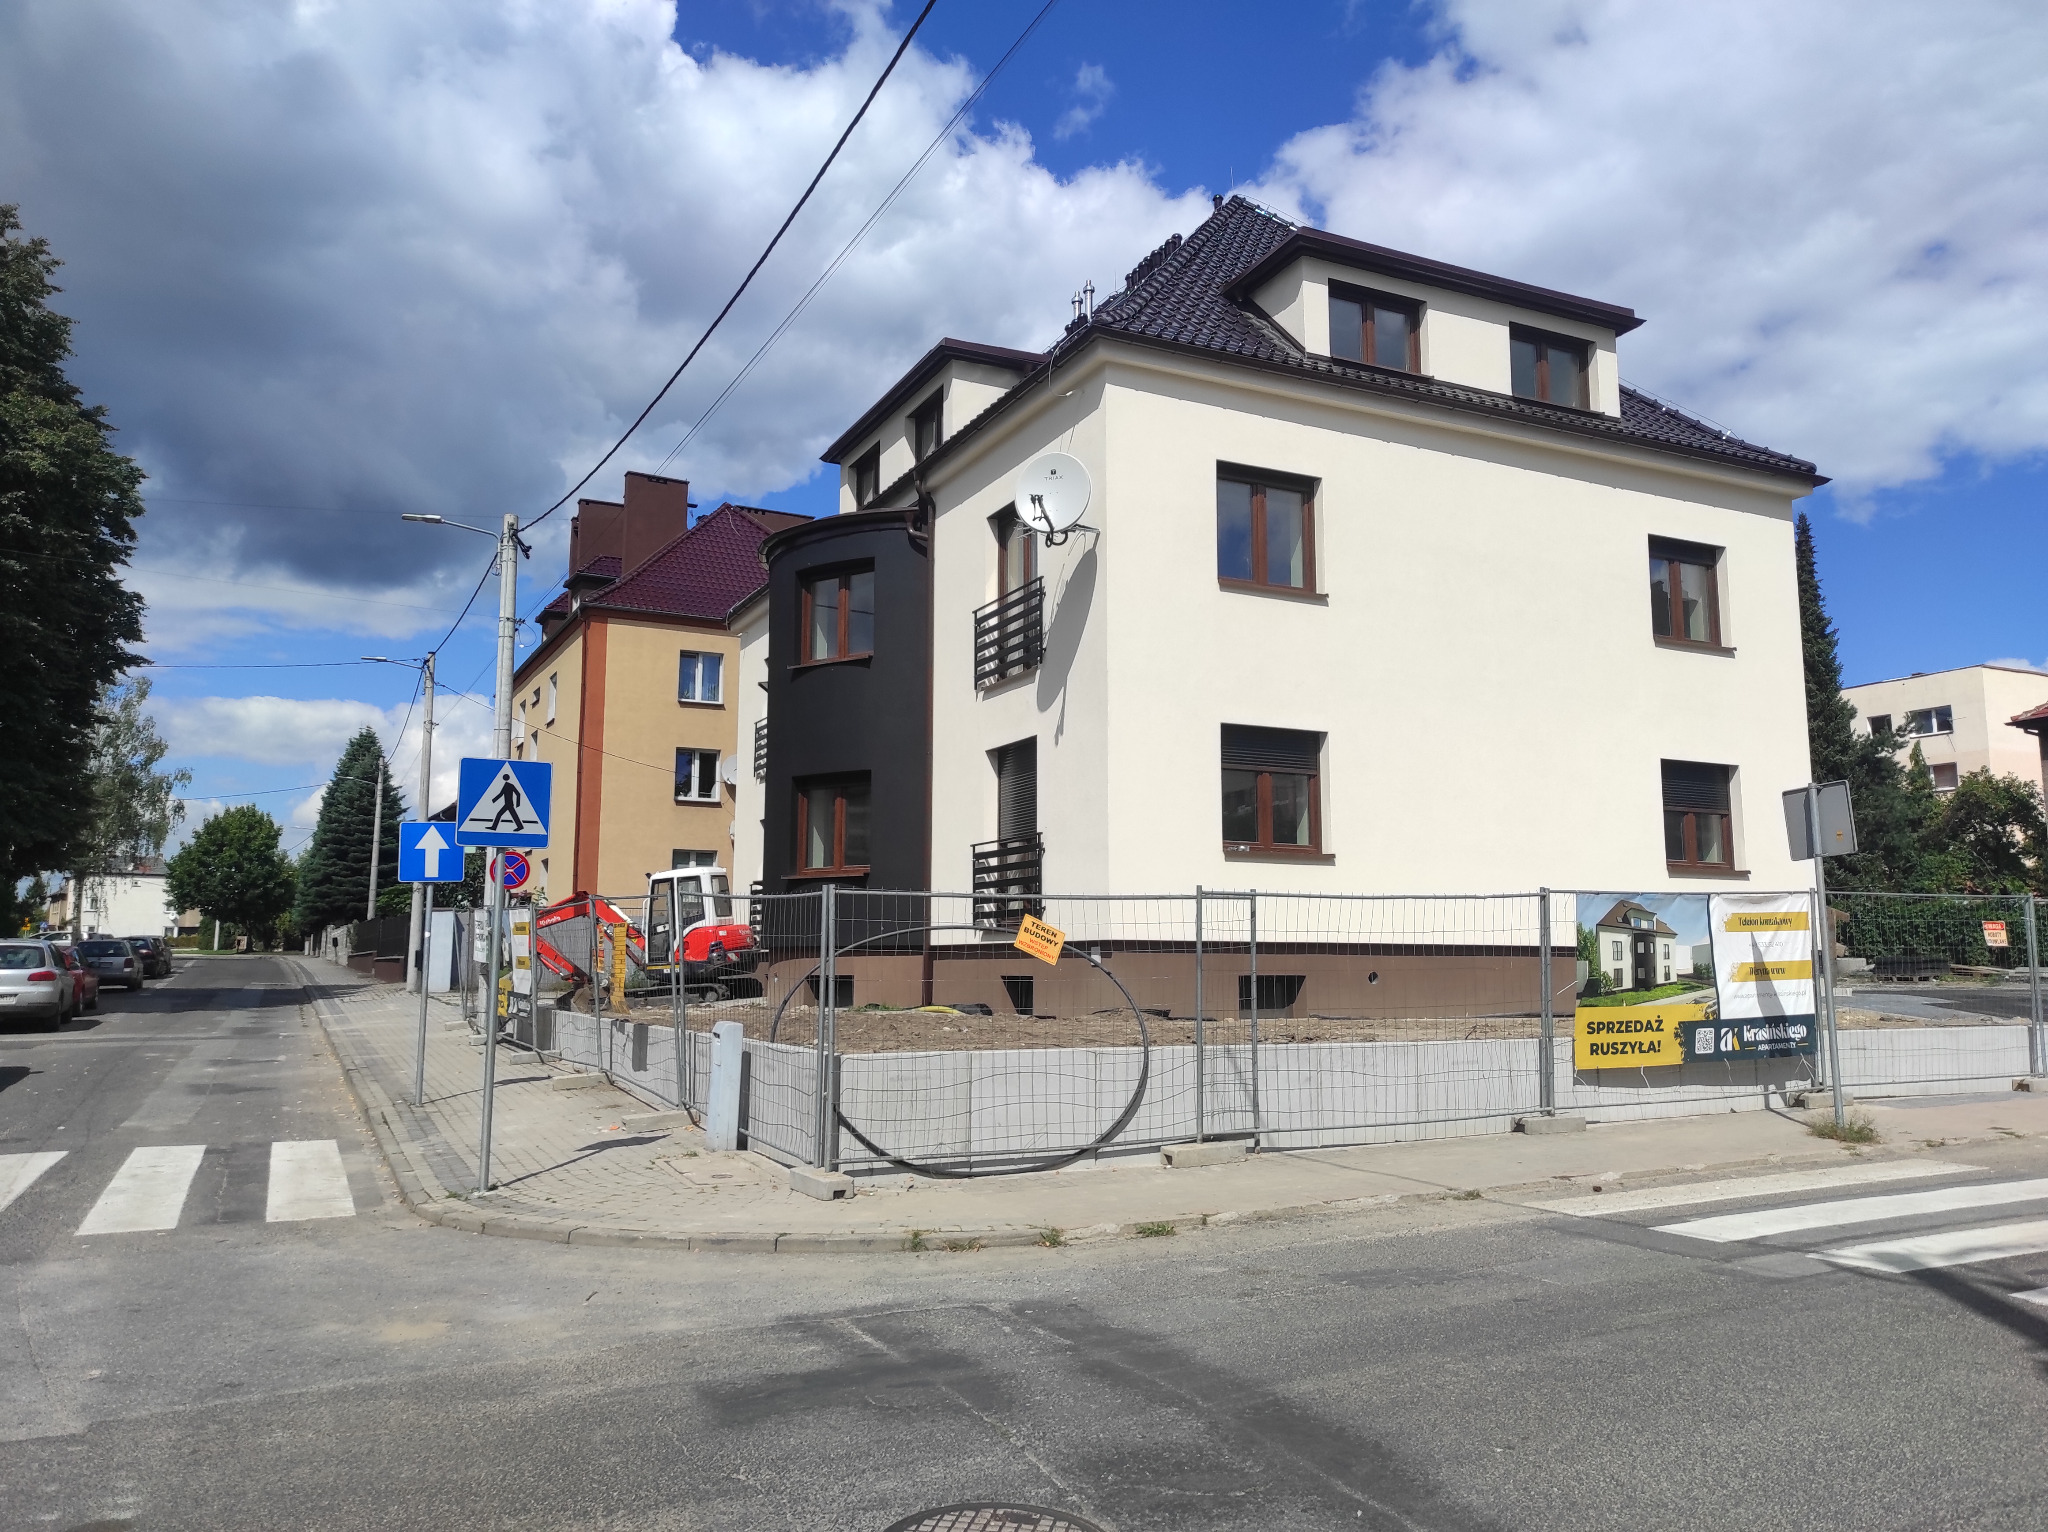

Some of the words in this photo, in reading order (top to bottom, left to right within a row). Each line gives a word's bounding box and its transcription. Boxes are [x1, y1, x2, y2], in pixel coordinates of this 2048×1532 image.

[1024, 927, 1058, 947] BUDOWY
[1031, 921, 1057, 938] TEREN
[1018, 940, 1056, 960] WZBRONIONY
[1586, 1015, 1664, 1035] SPRZEDAŻ
[1743, 1023, 1807, 1042] Krasińskiego
[1590, 1040, 1661, 1056] RUSZYŁA!
[1757, 1042, 1796, 1051] APARTAMENTY
